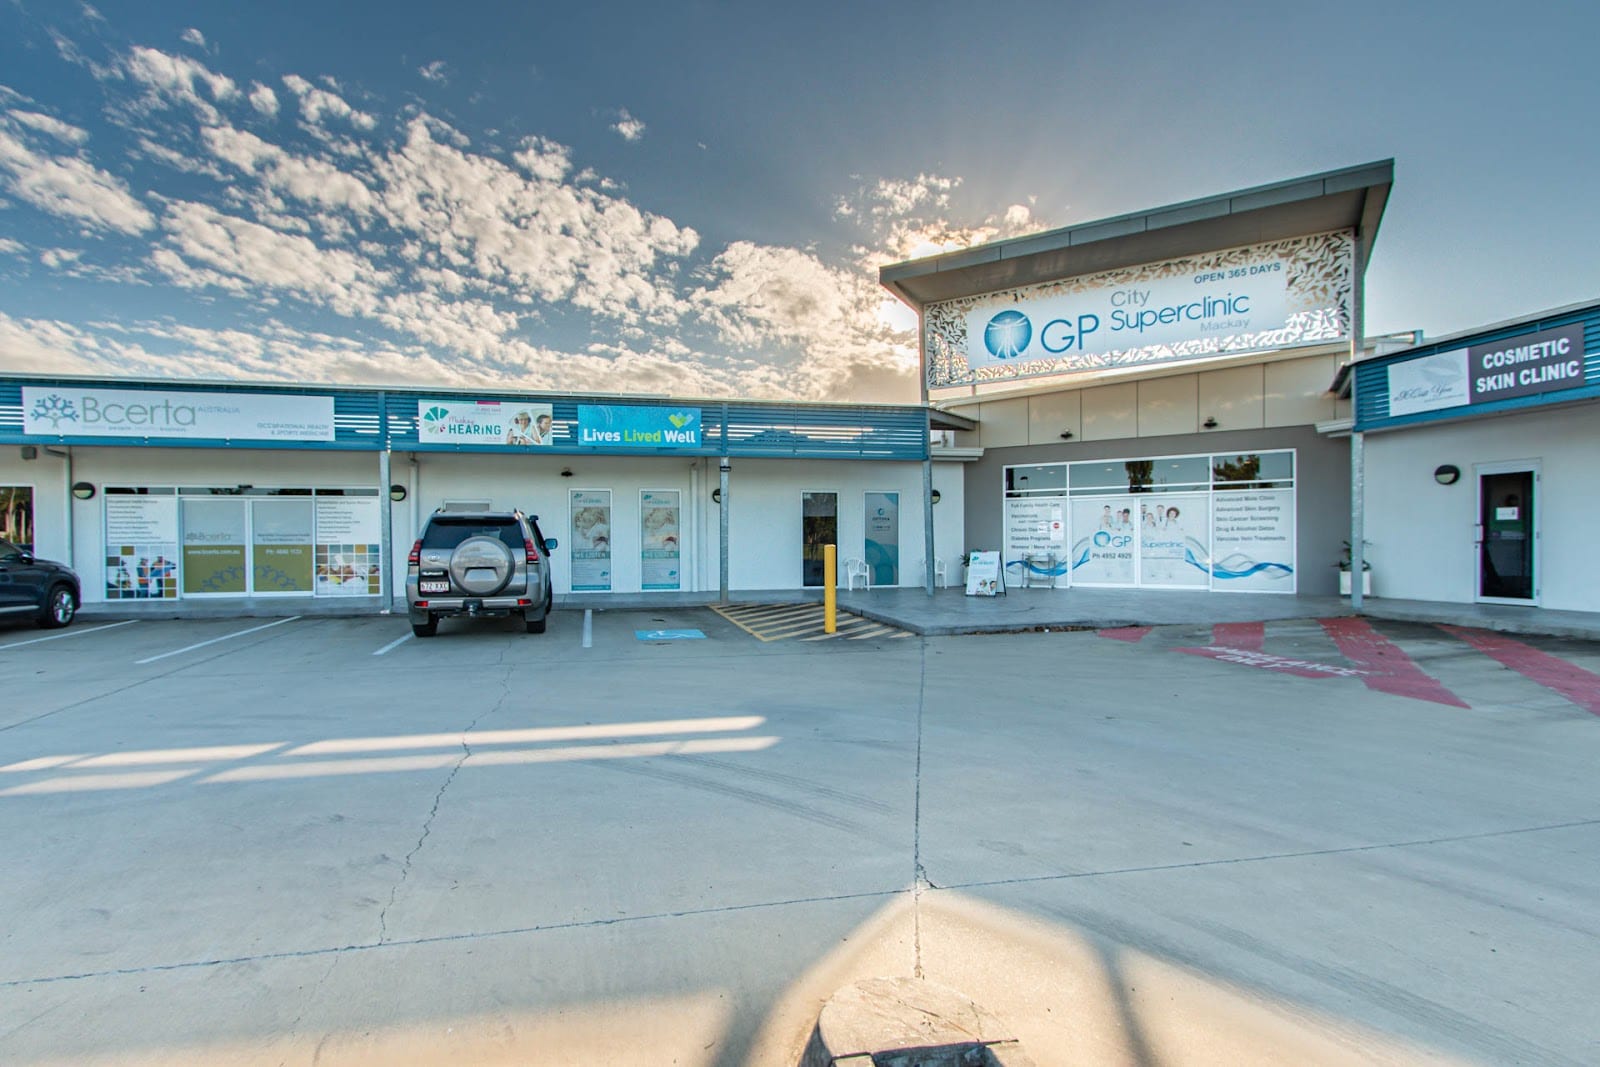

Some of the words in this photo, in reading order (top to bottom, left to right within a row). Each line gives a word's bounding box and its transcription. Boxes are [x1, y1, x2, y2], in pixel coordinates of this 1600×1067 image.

[1194, 272, 1225, 285] OPEN
[1228, 267, 1248, 279] 365
[1250, 262, 1281, 276] DAYS
[1110, 289, 1151, 307] City
[1040, 313, 1100, 354] GP
[1110, 292, 1250, 333] Superclinic
[1200, 318, 1250, 333] Mackay
[1482, 337, 1570, 369] COSMETIC
[1475, 371, 1515, 393] SKIN
[1519, 360, 1580, 386] CLINIC
[81, 396, 196, 426] Bcerta
[198, 406, 240, 414] AUSTRALIA
[583, 428, 620, 442] Lives
[624, 429, 661, 443] Lived
[664, 430, 696, 443] Well
[1111, 535, 1132, 548] GP
